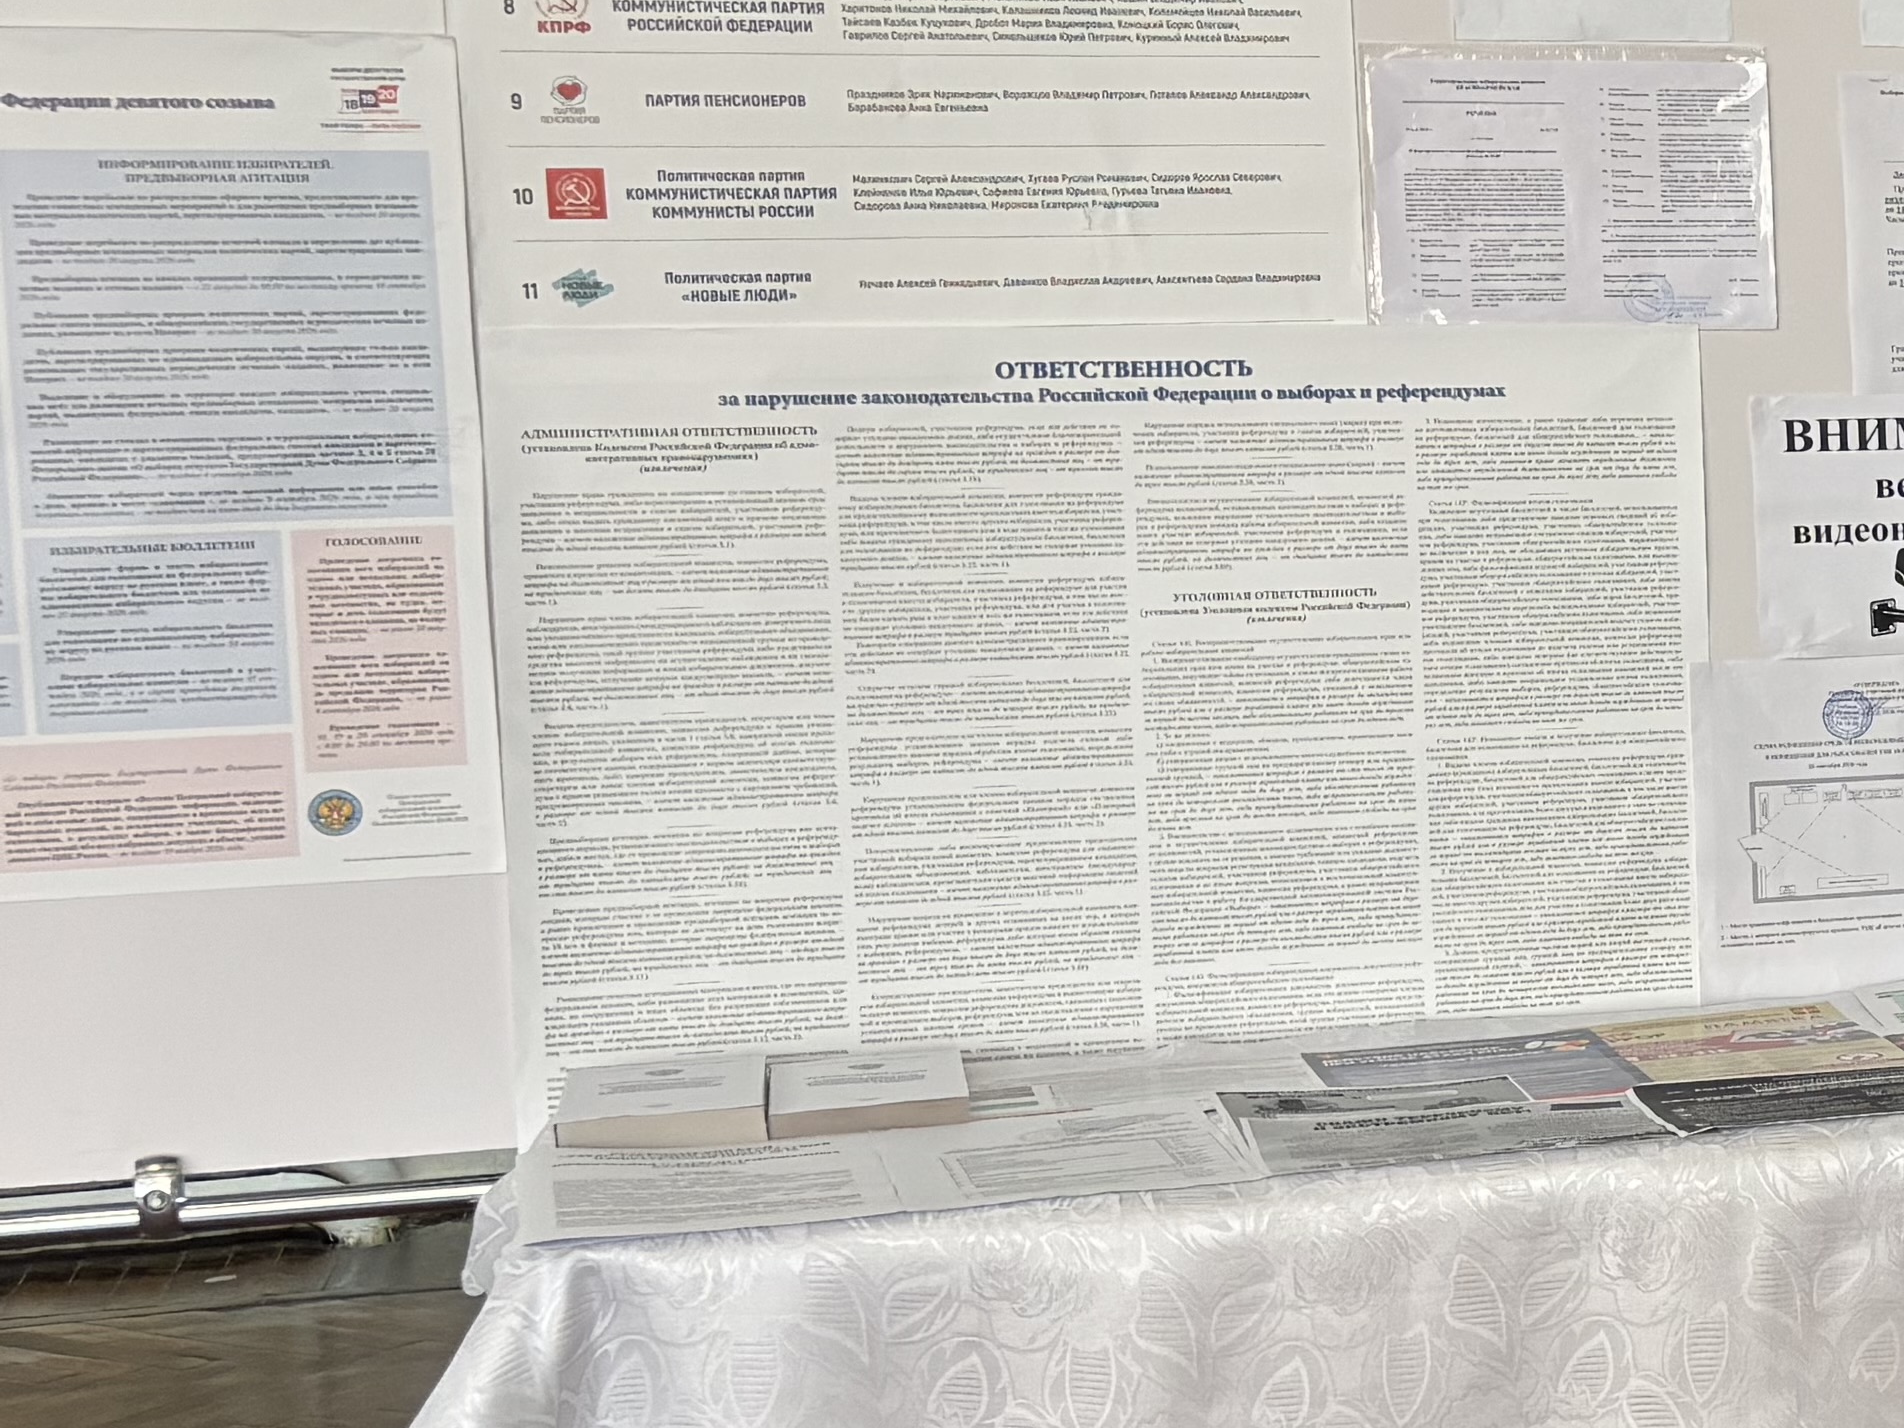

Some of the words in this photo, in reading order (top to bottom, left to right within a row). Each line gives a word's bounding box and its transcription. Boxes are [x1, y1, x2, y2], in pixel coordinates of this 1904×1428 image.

[611, 0, 767, 14] КОММУНИСТИЧЕСКАЯ
[770, 1, 825, 15] ПАРТИЯ
[536, 20, 592, 34] КПРФ
[626, 16, 723, 32] РОССИЙСКОЙ
[725, 19, 813, 34] ФЕДЕРАЦИИ
[0, 93, 112, 112] Федерации
[204, 98, 276, 110] созыва
[510, 92, 522, 110] 9
[645, 93, 701, 107] ПАРТИЯ
[703, 94, 807, 107] ПЕНСИОНЕРОВ
[657, 169, 755, 182] Политическая
[758, 171, 805, 184] партия
[513, 187, 534, 205] 10
[625, 187, 780, 201] КОММУНИСТИЧЕСКАЯ
[783, 187, 838, 200] ПАРТИЯ
[651, 205, 755, 219] КОММУНИСТЫ
[758, 205, 815, 218] РОССИИ
[664, 272, 763, 284] Политическая
[765, 272, 812, 285] партия
[521, 282, 539, 299] 11
[681, 289, 741, 302] «НОВЫЕ
[743, 288, 797, 302] ЛЮДИ»
[995, 359, 1253, 379] ОТВЕТСТВЕННОСТЬ
[718, 394, 740, 407] за
[744, 394, 858, 410] нарушение
[861, 392, 1034, 406] законодательства
[1038, 387, 1149, 403] Российской
[1152, 386, 1257, 405] Федерации
[1260, 389, 1273, 400] о
[1276, 384, 1357, 404] выборах
[1359, 387, 1372, 399] и
[1376, 384, 1506, 403] референдумах
